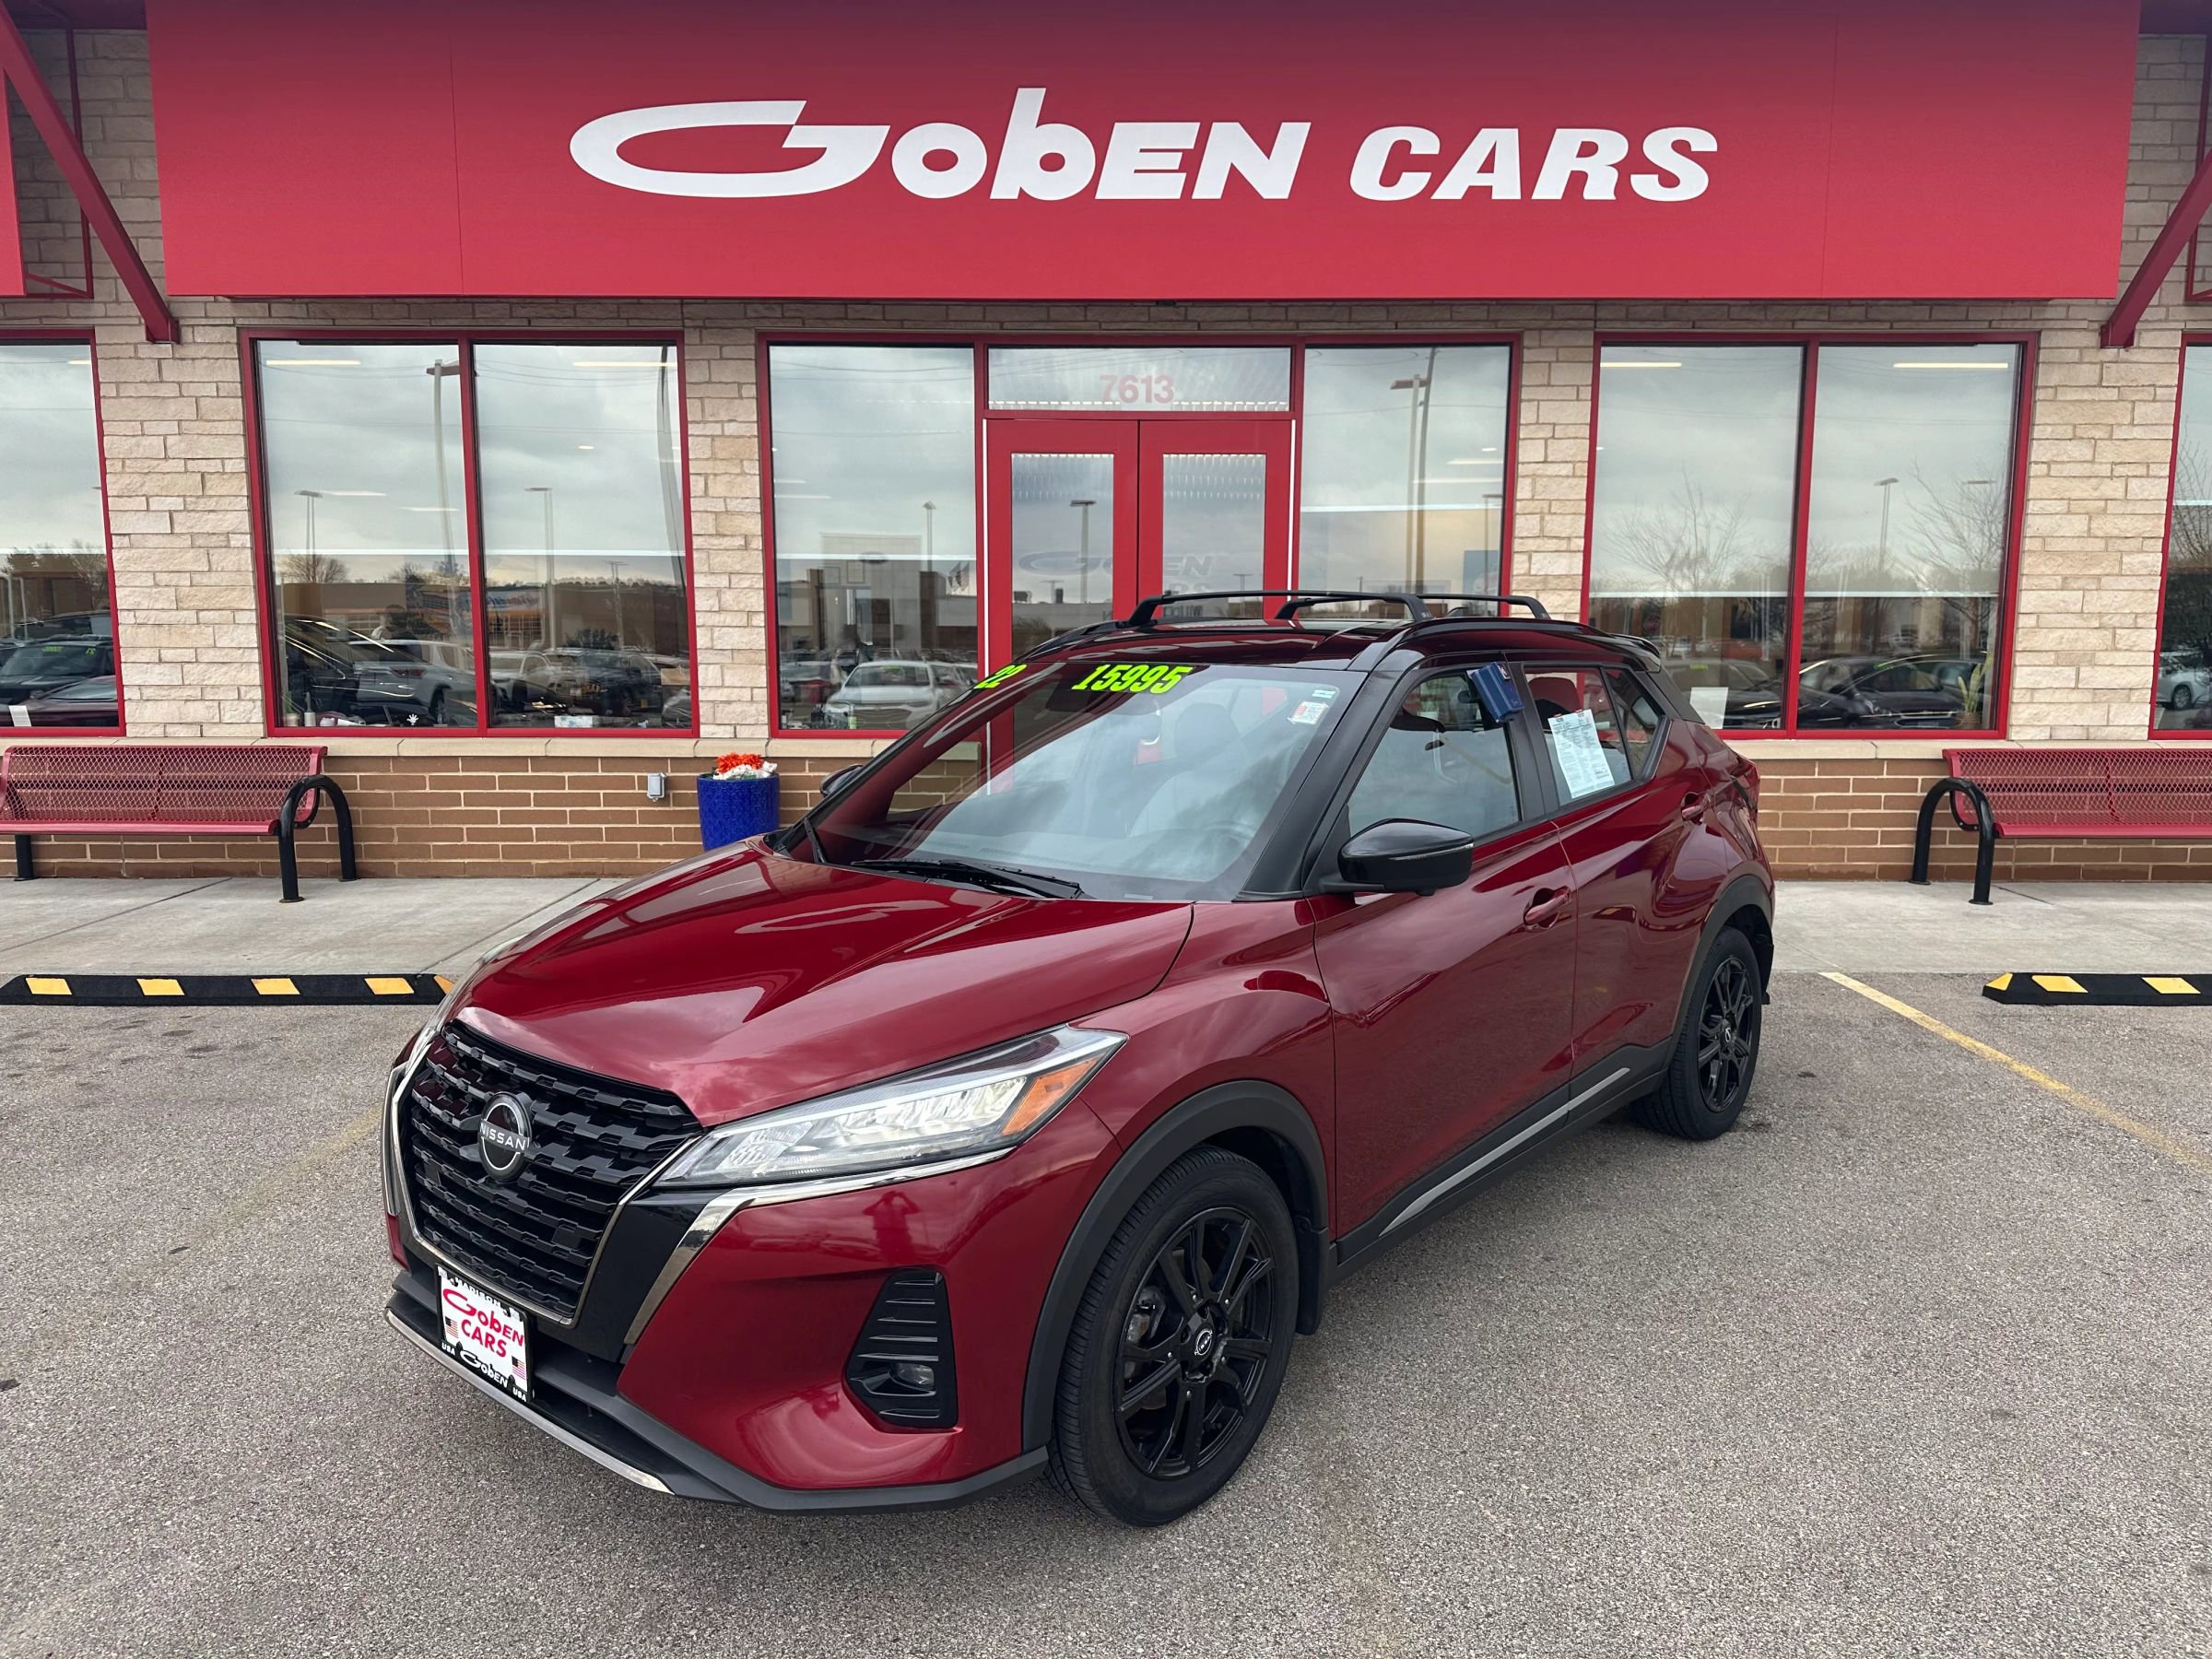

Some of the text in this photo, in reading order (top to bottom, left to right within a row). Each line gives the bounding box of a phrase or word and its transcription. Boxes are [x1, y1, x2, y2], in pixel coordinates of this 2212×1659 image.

[1349, 125, 1717, 201] CARS
[1099, 374, 1175, 404] 7613
[1071, 664, 1194, 694] 15995
[479, 1122, 526, 1151] NISSAN
[461, 1319, 507, 1358] CARS
[441, 1342, 456, 1356] USA
[512, 1387, 527, 1403] USA
